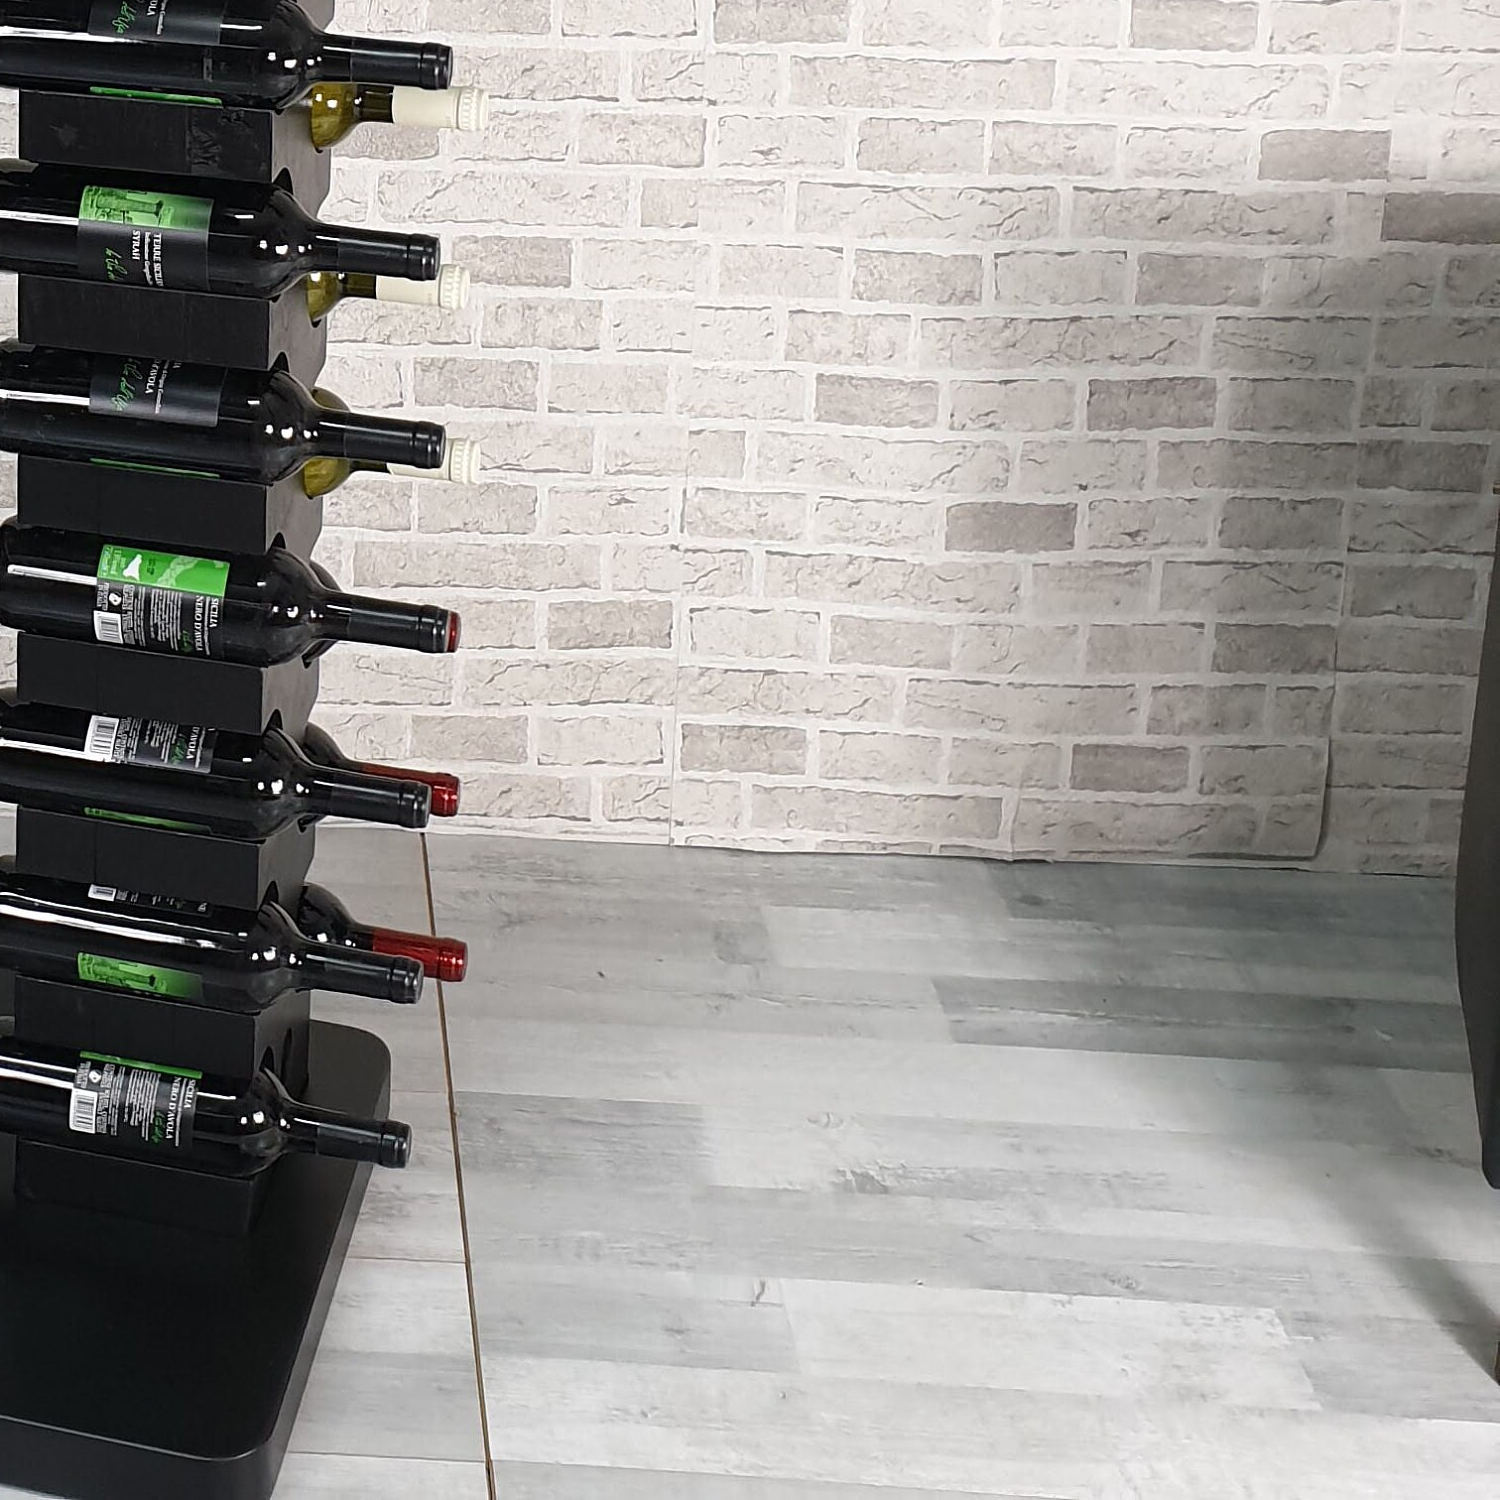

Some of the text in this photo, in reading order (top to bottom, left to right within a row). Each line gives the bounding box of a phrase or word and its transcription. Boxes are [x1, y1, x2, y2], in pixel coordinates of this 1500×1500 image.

[132, 230, 141, 260] SYRAH
[153, 233, 162, 262] TERRE
[195, 596, 204, 621] NERO
[209, 598, 219, 628] SICILIA
[171, 1076, 181, 1101] NERO
[183, 1079, 196, 1109] SICILIA
[165, 1102, 177, 1139] D'AVOLA
